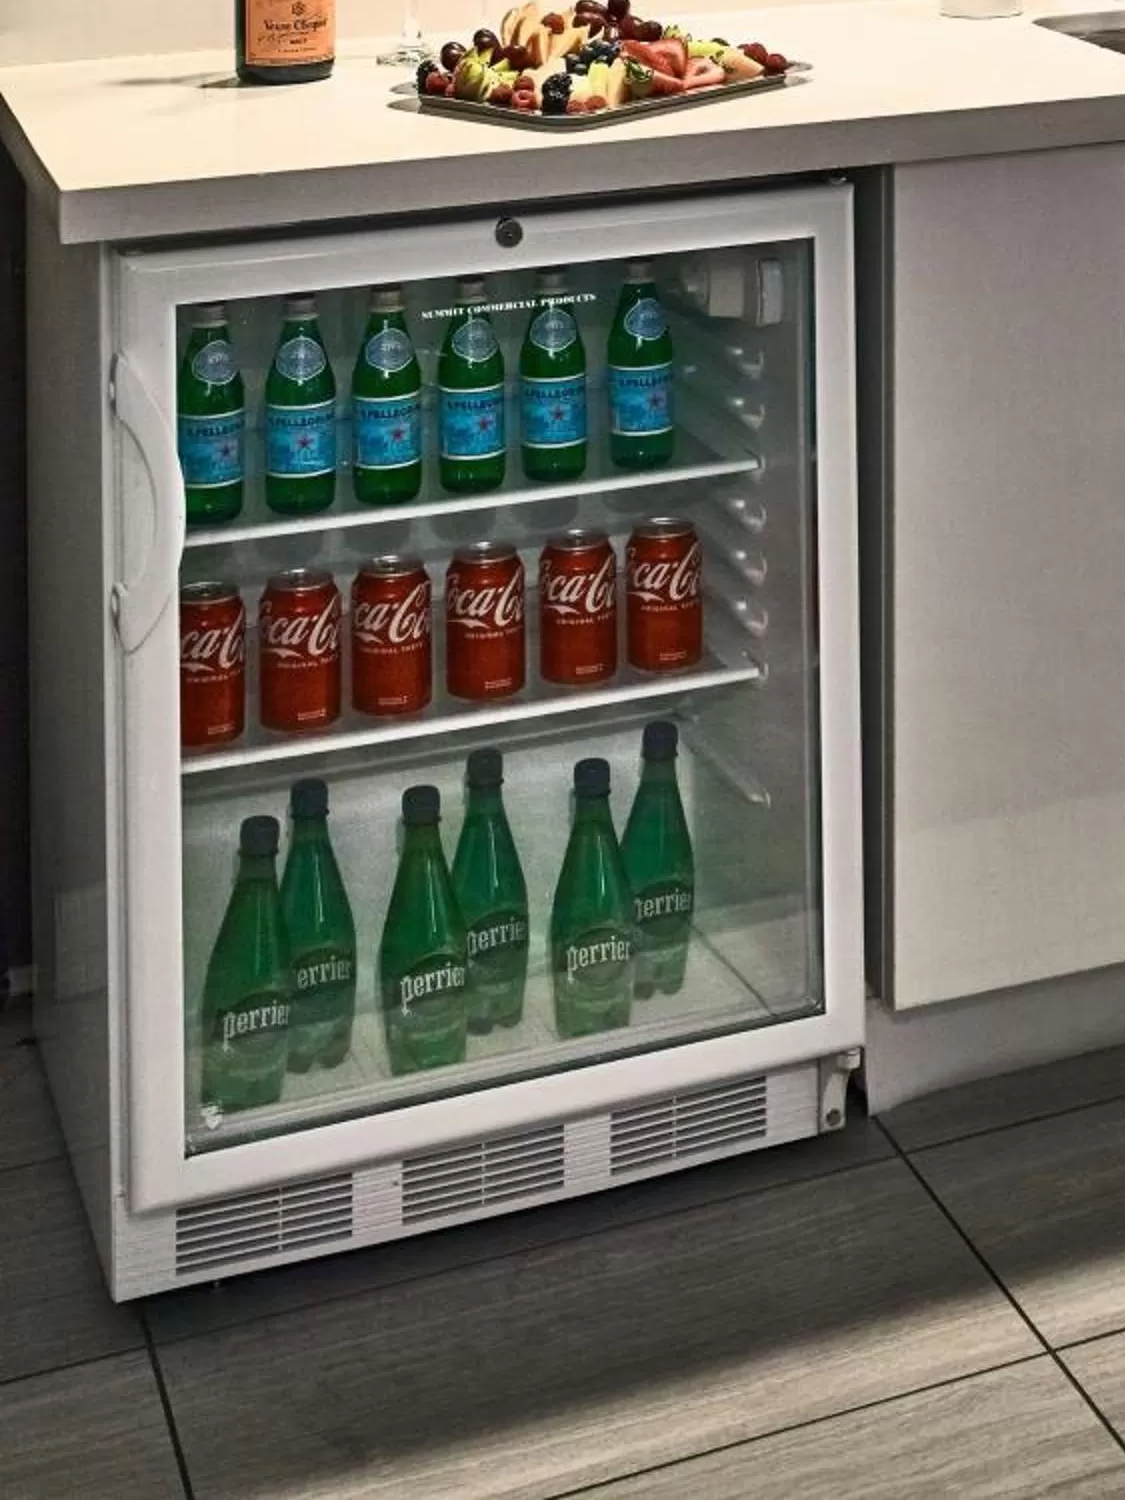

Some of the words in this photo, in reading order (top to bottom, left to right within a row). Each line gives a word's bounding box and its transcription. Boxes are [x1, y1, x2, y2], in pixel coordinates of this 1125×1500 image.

[467, 299, 538, 315] COMMERCIAL
[540, 293, 597, 307] PRODUCTS
[297, 955, 352, 989] errier
[566, 935, 631, 984] perrier
[400, 961, 466, 1017] perrier
